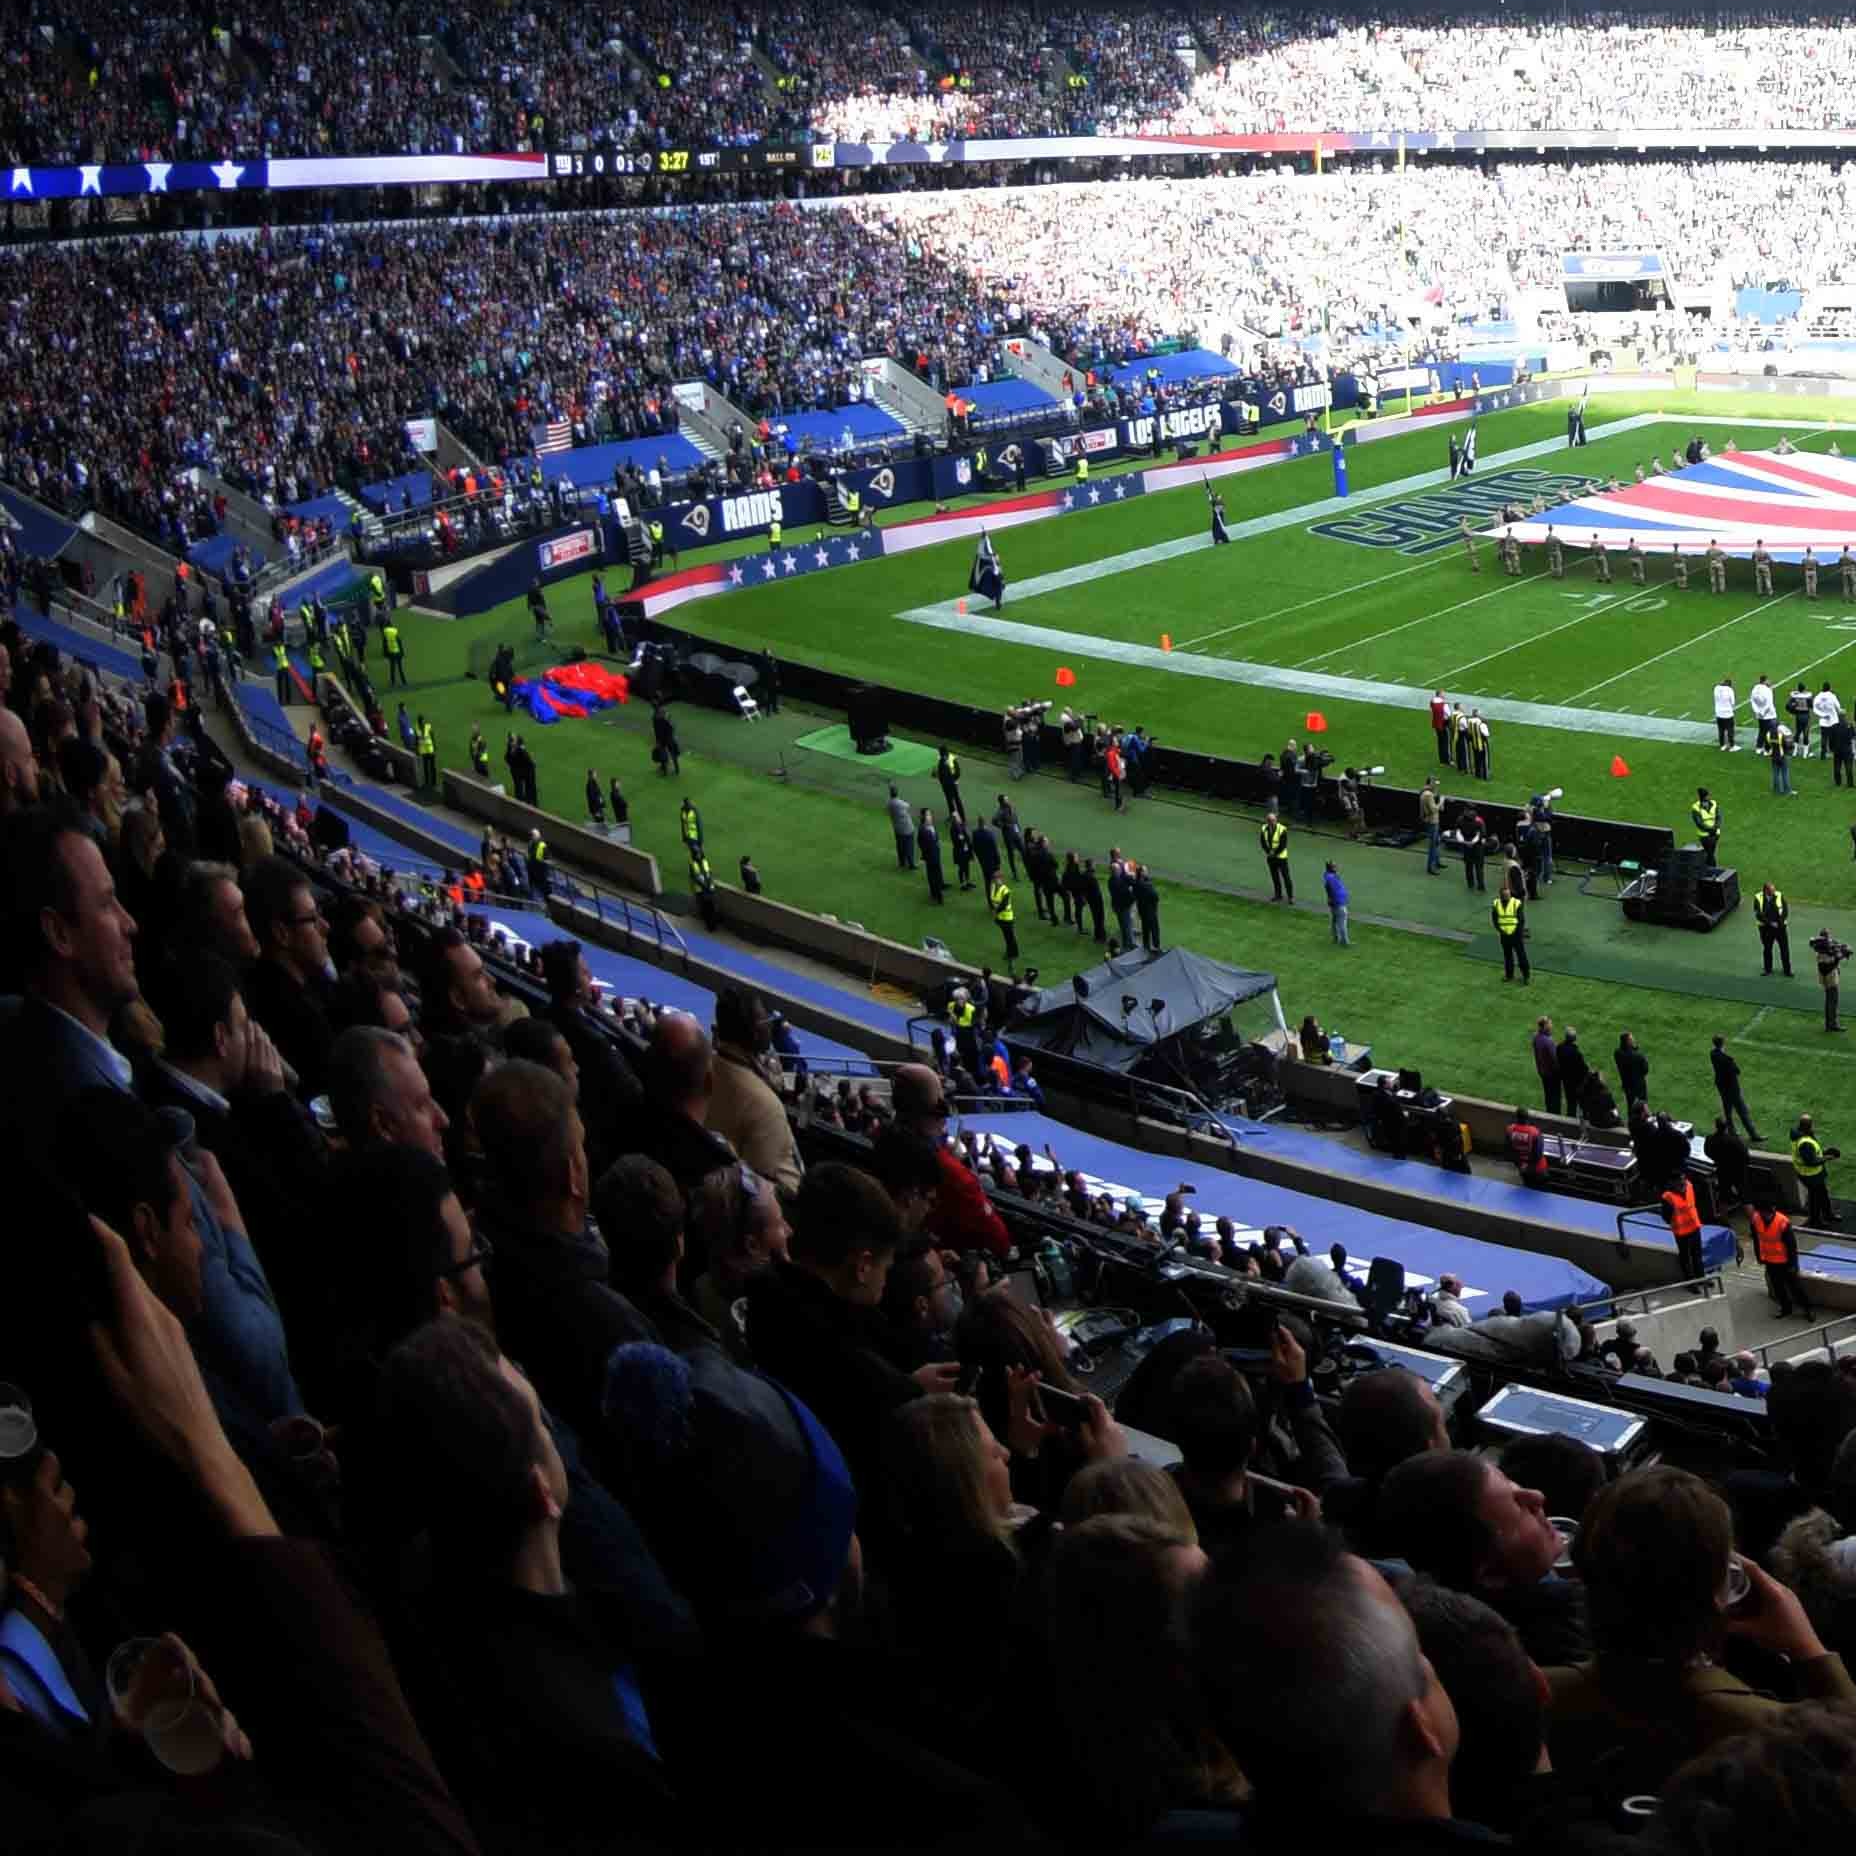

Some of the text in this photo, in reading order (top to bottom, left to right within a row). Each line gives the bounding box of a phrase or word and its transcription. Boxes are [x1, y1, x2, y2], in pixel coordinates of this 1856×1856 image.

[594, 155, 604, 172] 0
[616, 155, 625, 172] 0
[660, 152, 688, 171] 3:27
[1294, 382, 1332, 412] RAMS
[1128, 417, 1155, 445] LOS
[722, 490, 783, 532] RAMS
